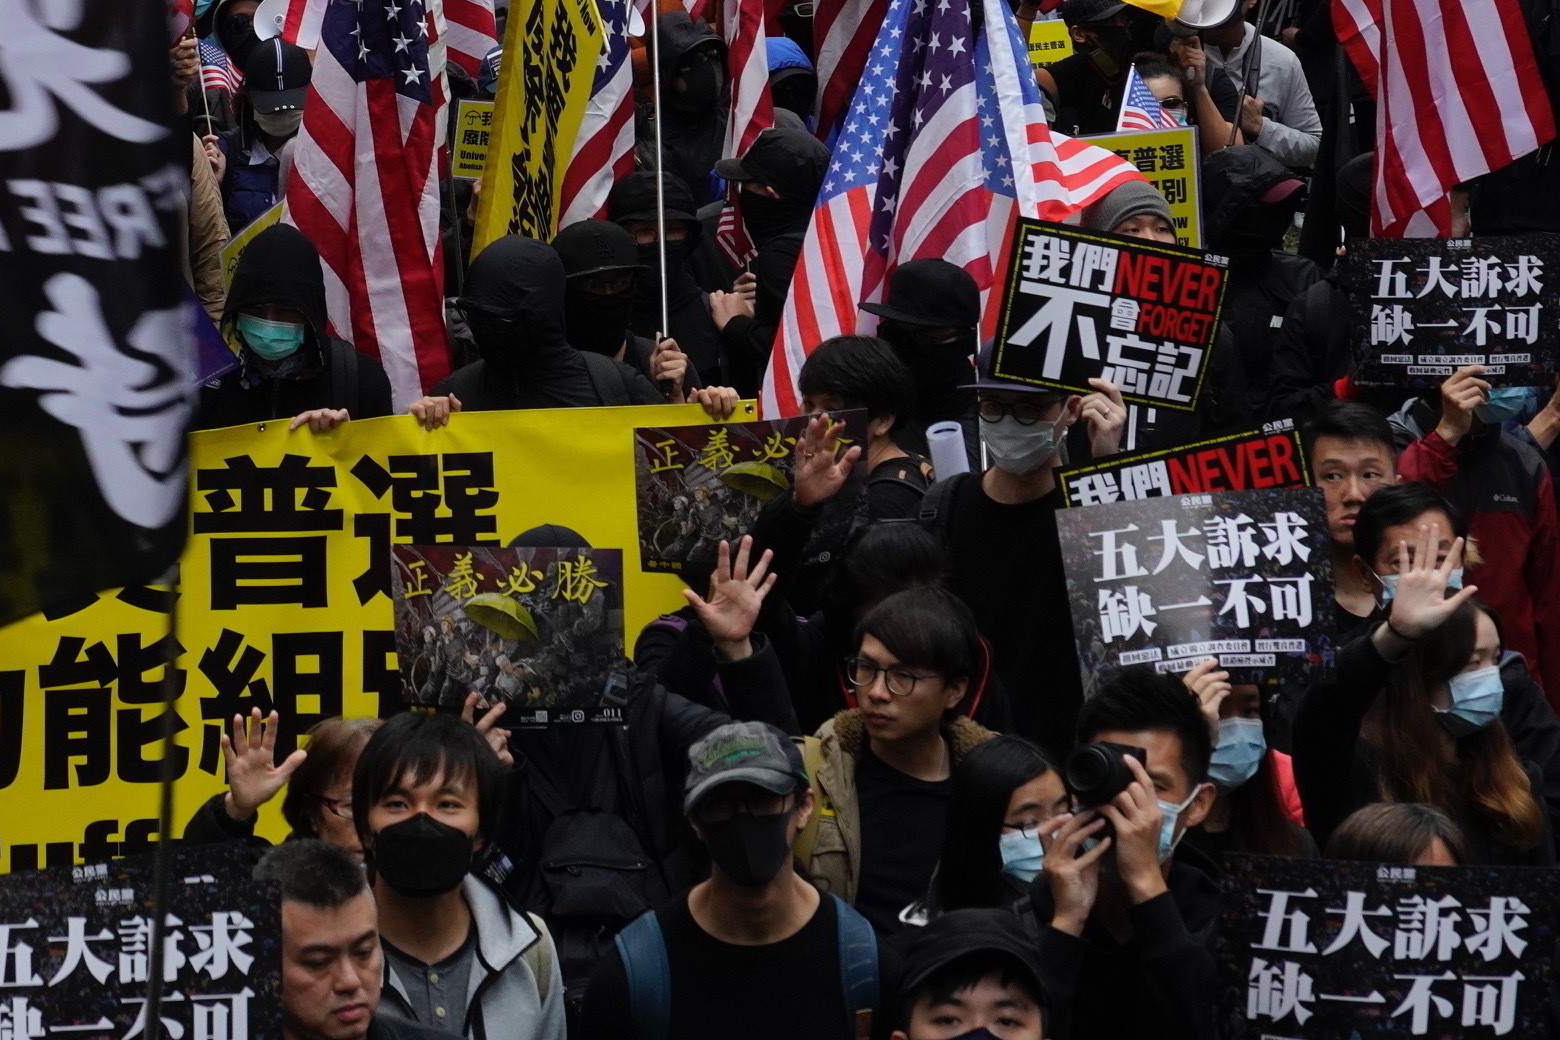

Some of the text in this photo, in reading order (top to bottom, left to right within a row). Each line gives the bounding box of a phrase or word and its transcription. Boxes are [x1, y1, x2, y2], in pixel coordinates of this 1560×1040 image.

[1022, 233, 1222, 312] 我們 NEVER
[1371, 255, 1544, 299] 五大訴求
[1139, 302, 1215, 346] FORGET
[1371, 302, 1544, 347] 缺一不可
[1102, 333, 1204, 403] 忘記
[1069, 432, 1302, 507] 我們 NEVER
[404, 552, 608, 605] 正義必勝
[1089, 511, 1313, 585] 五大訴求
[1097, 572, 1314, 644] 缺一不可
[95, 888, 134, 902] 公民黨
[1376, 867, 1416, 881] 公民黨
[1249, 888, 1532, 963] 五大訴求
[1247, 959, 1526, 1037] 缺一不可
